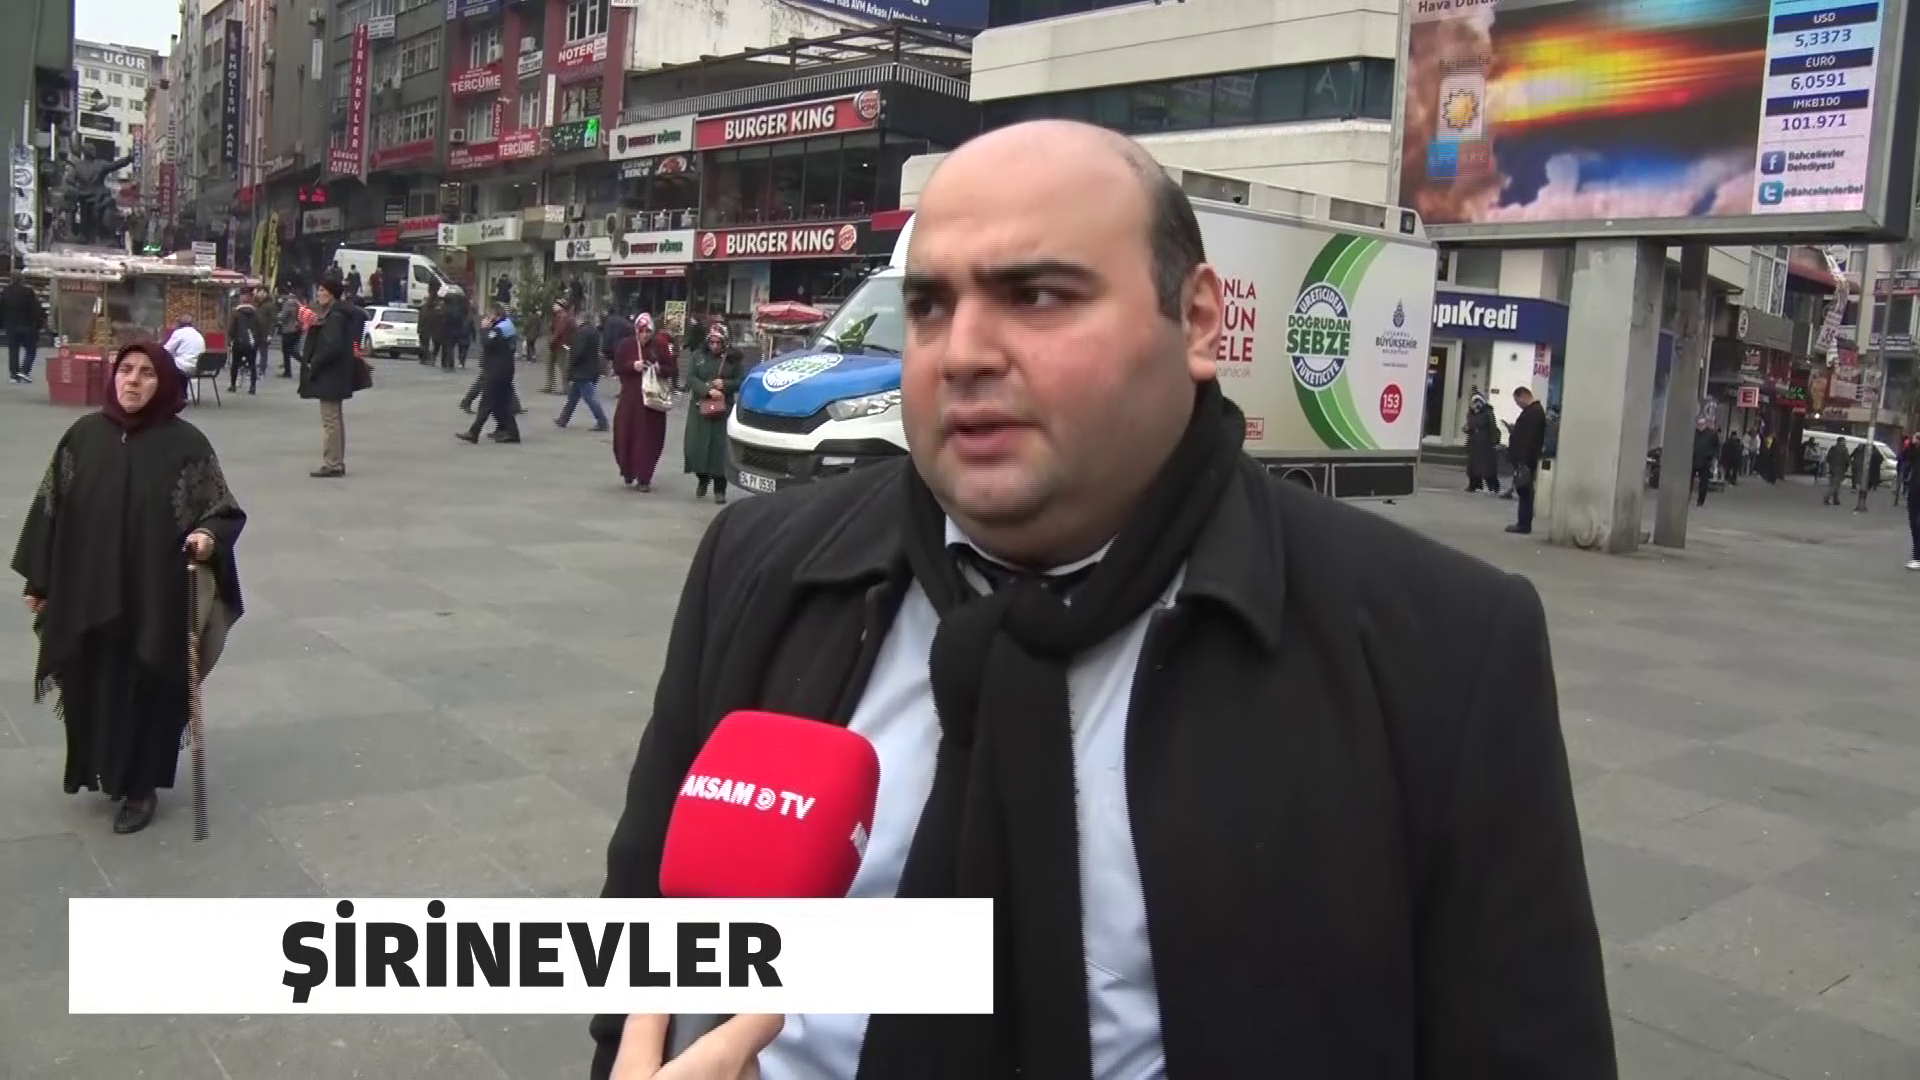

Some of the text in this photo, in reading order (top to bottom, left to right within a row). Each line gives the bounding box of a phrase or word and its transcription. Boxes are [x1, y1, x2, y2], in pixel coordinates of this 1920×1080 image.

[1418, 0, 1451, 12] Hava
[1813, 13, 1836, 24] USD
[1795, 29, 1852, 47] 5,3373
[558, 43, 594, 63] NOTER
[1805, 55, 1836, 68] EURO
[1791, 72, 1847, 90] 6,0591
[226, 54, 237, 158] ENGLISH PARK
[1793, 96, 1841, 109] IMKB100
[725, 105, 836, 141] BURGER KING
[1782, 114, 1848, 131] 101.971
[726, 228, 835, 255] BURGER KING
[1286, 328, 1351, 357] SEBZE
[1383, 393, 1400, 409] 153
[780, 790, 816, 820] TV
